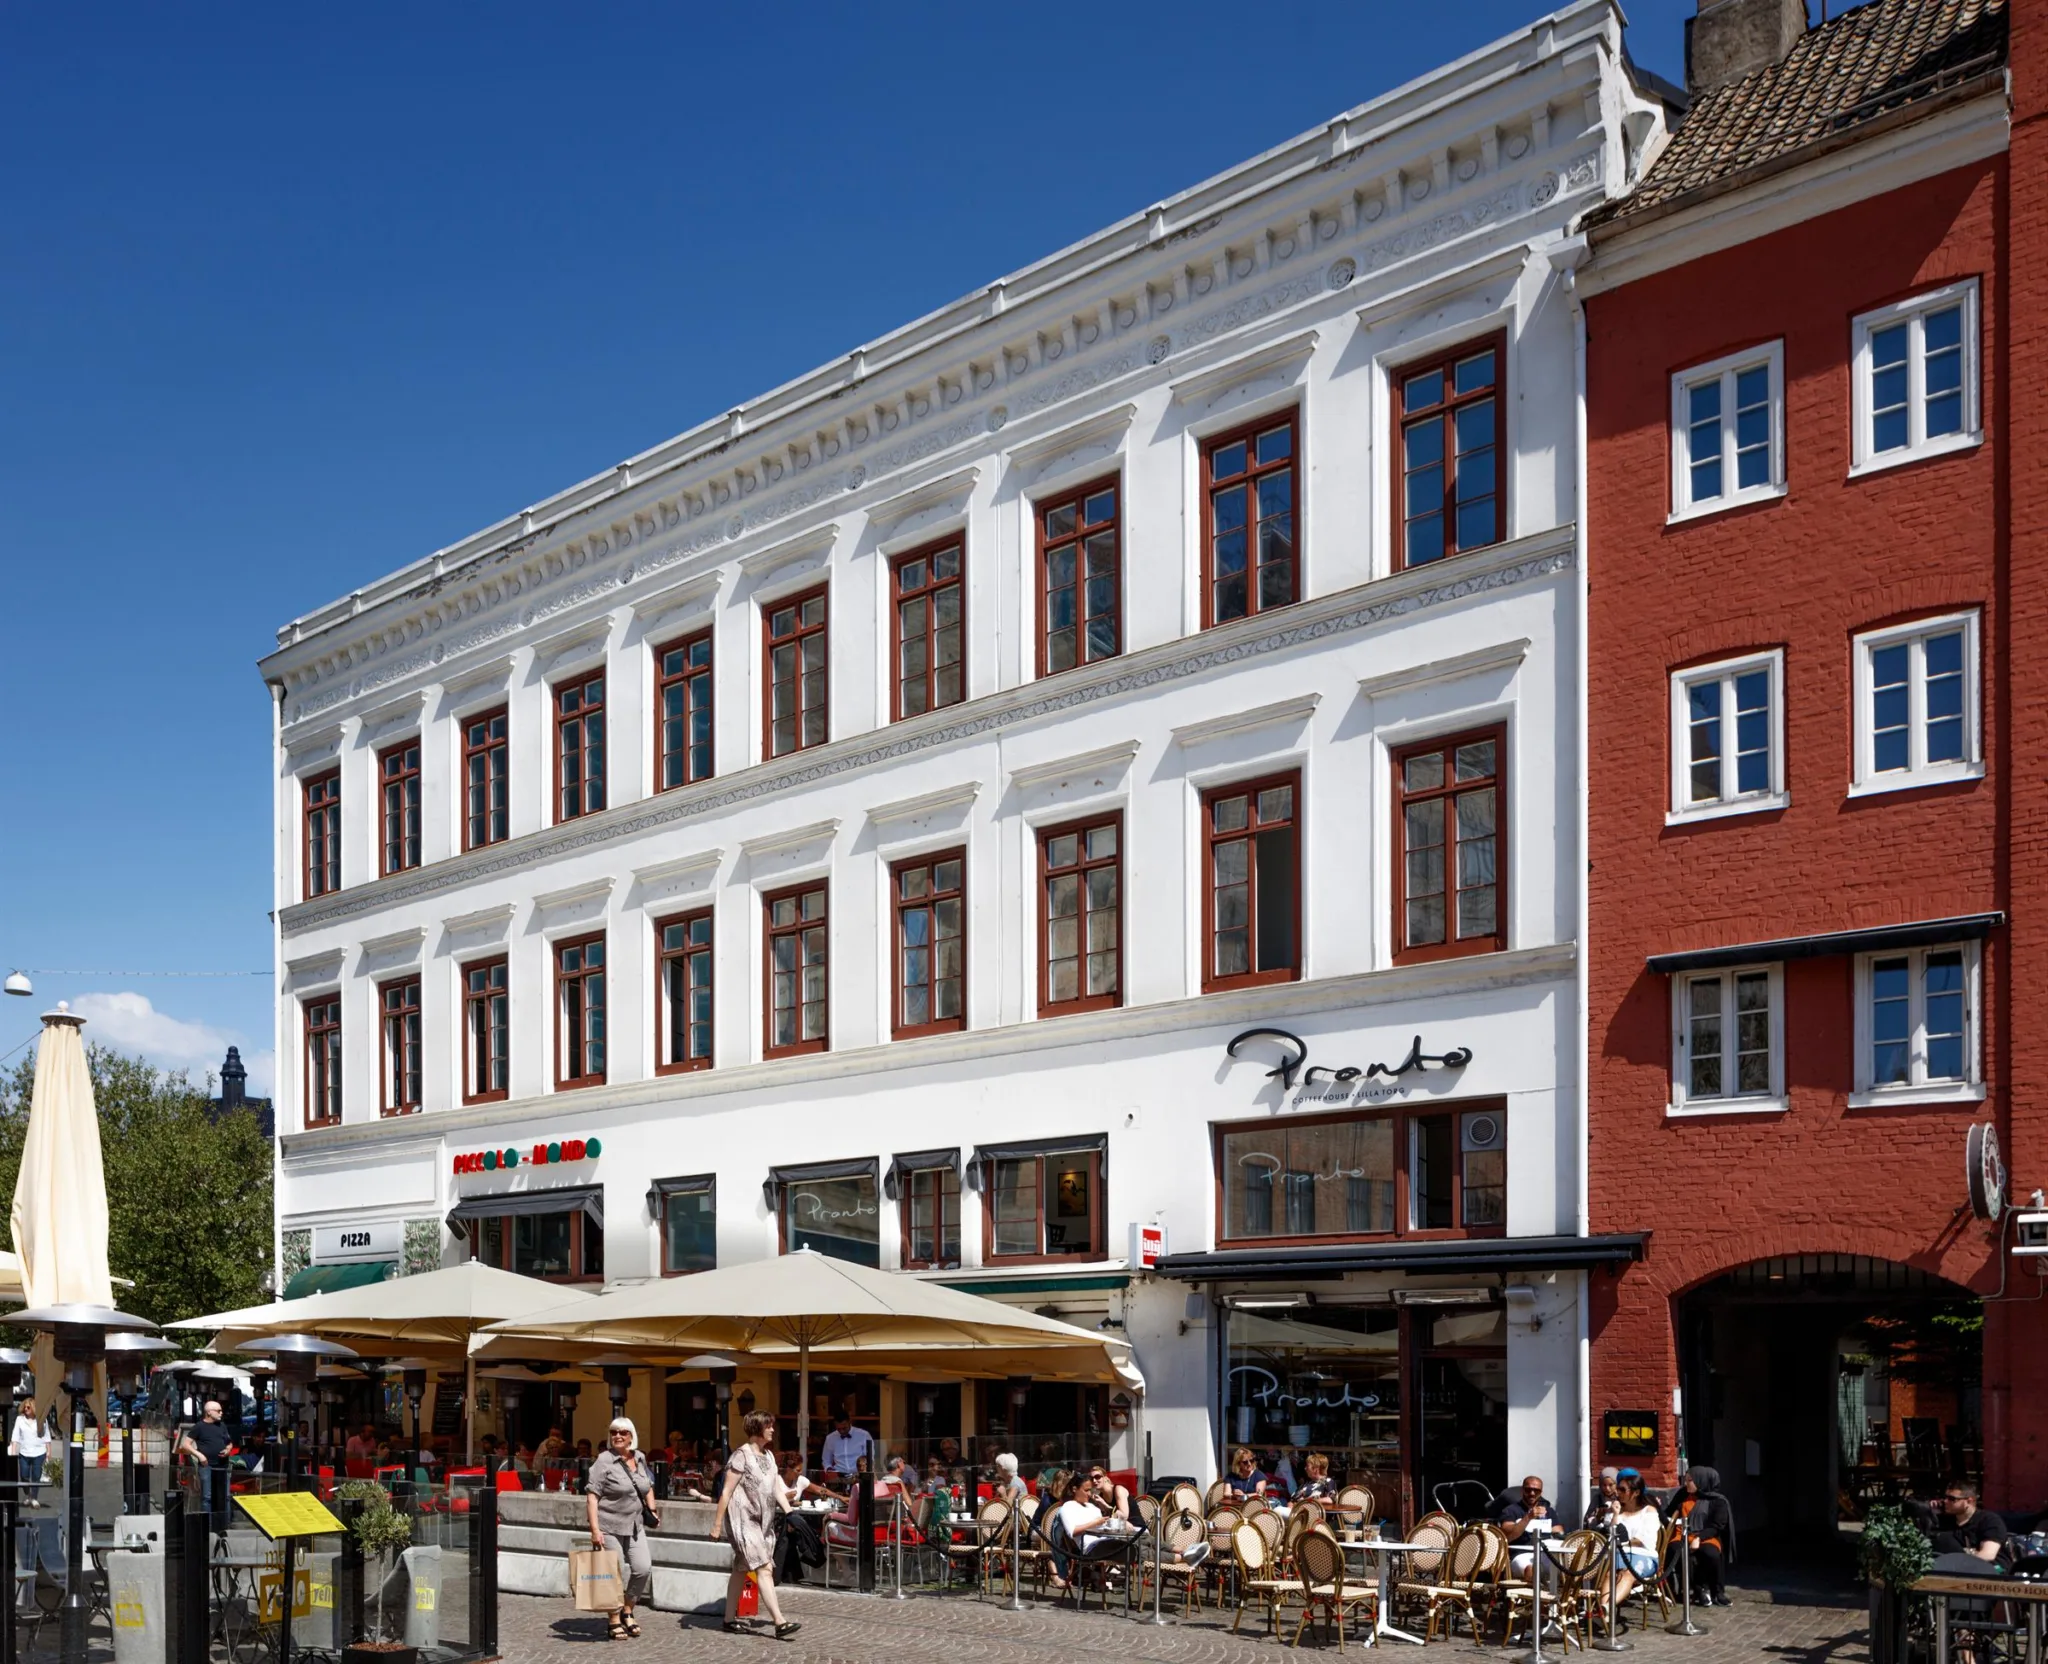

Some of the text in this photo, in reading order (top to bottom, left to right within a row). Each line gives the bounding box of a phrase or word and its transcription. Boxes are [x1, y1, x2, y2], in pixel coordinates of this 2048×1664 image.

[1227, 1028, 1473, 1090] Pronto
[1292, 1086, 1406, 1106] COFFEEHOUSE LILLA TORG
[453, 1147, 519, 1175] PICCOLO
[532, 1137, 602, 1166] MONDO
[1238, 1151, 1365, 1185] Pronto
[793, 1192, 878, 1221] Pronto
[340, 1231, 371, 1248] PIZZA
[1227, 1365, 1380, 1408] Pronto
[1608, 1426, 1654, 1440] KIND
[1966, 1582, 2021, 1595] ESPRESSO
